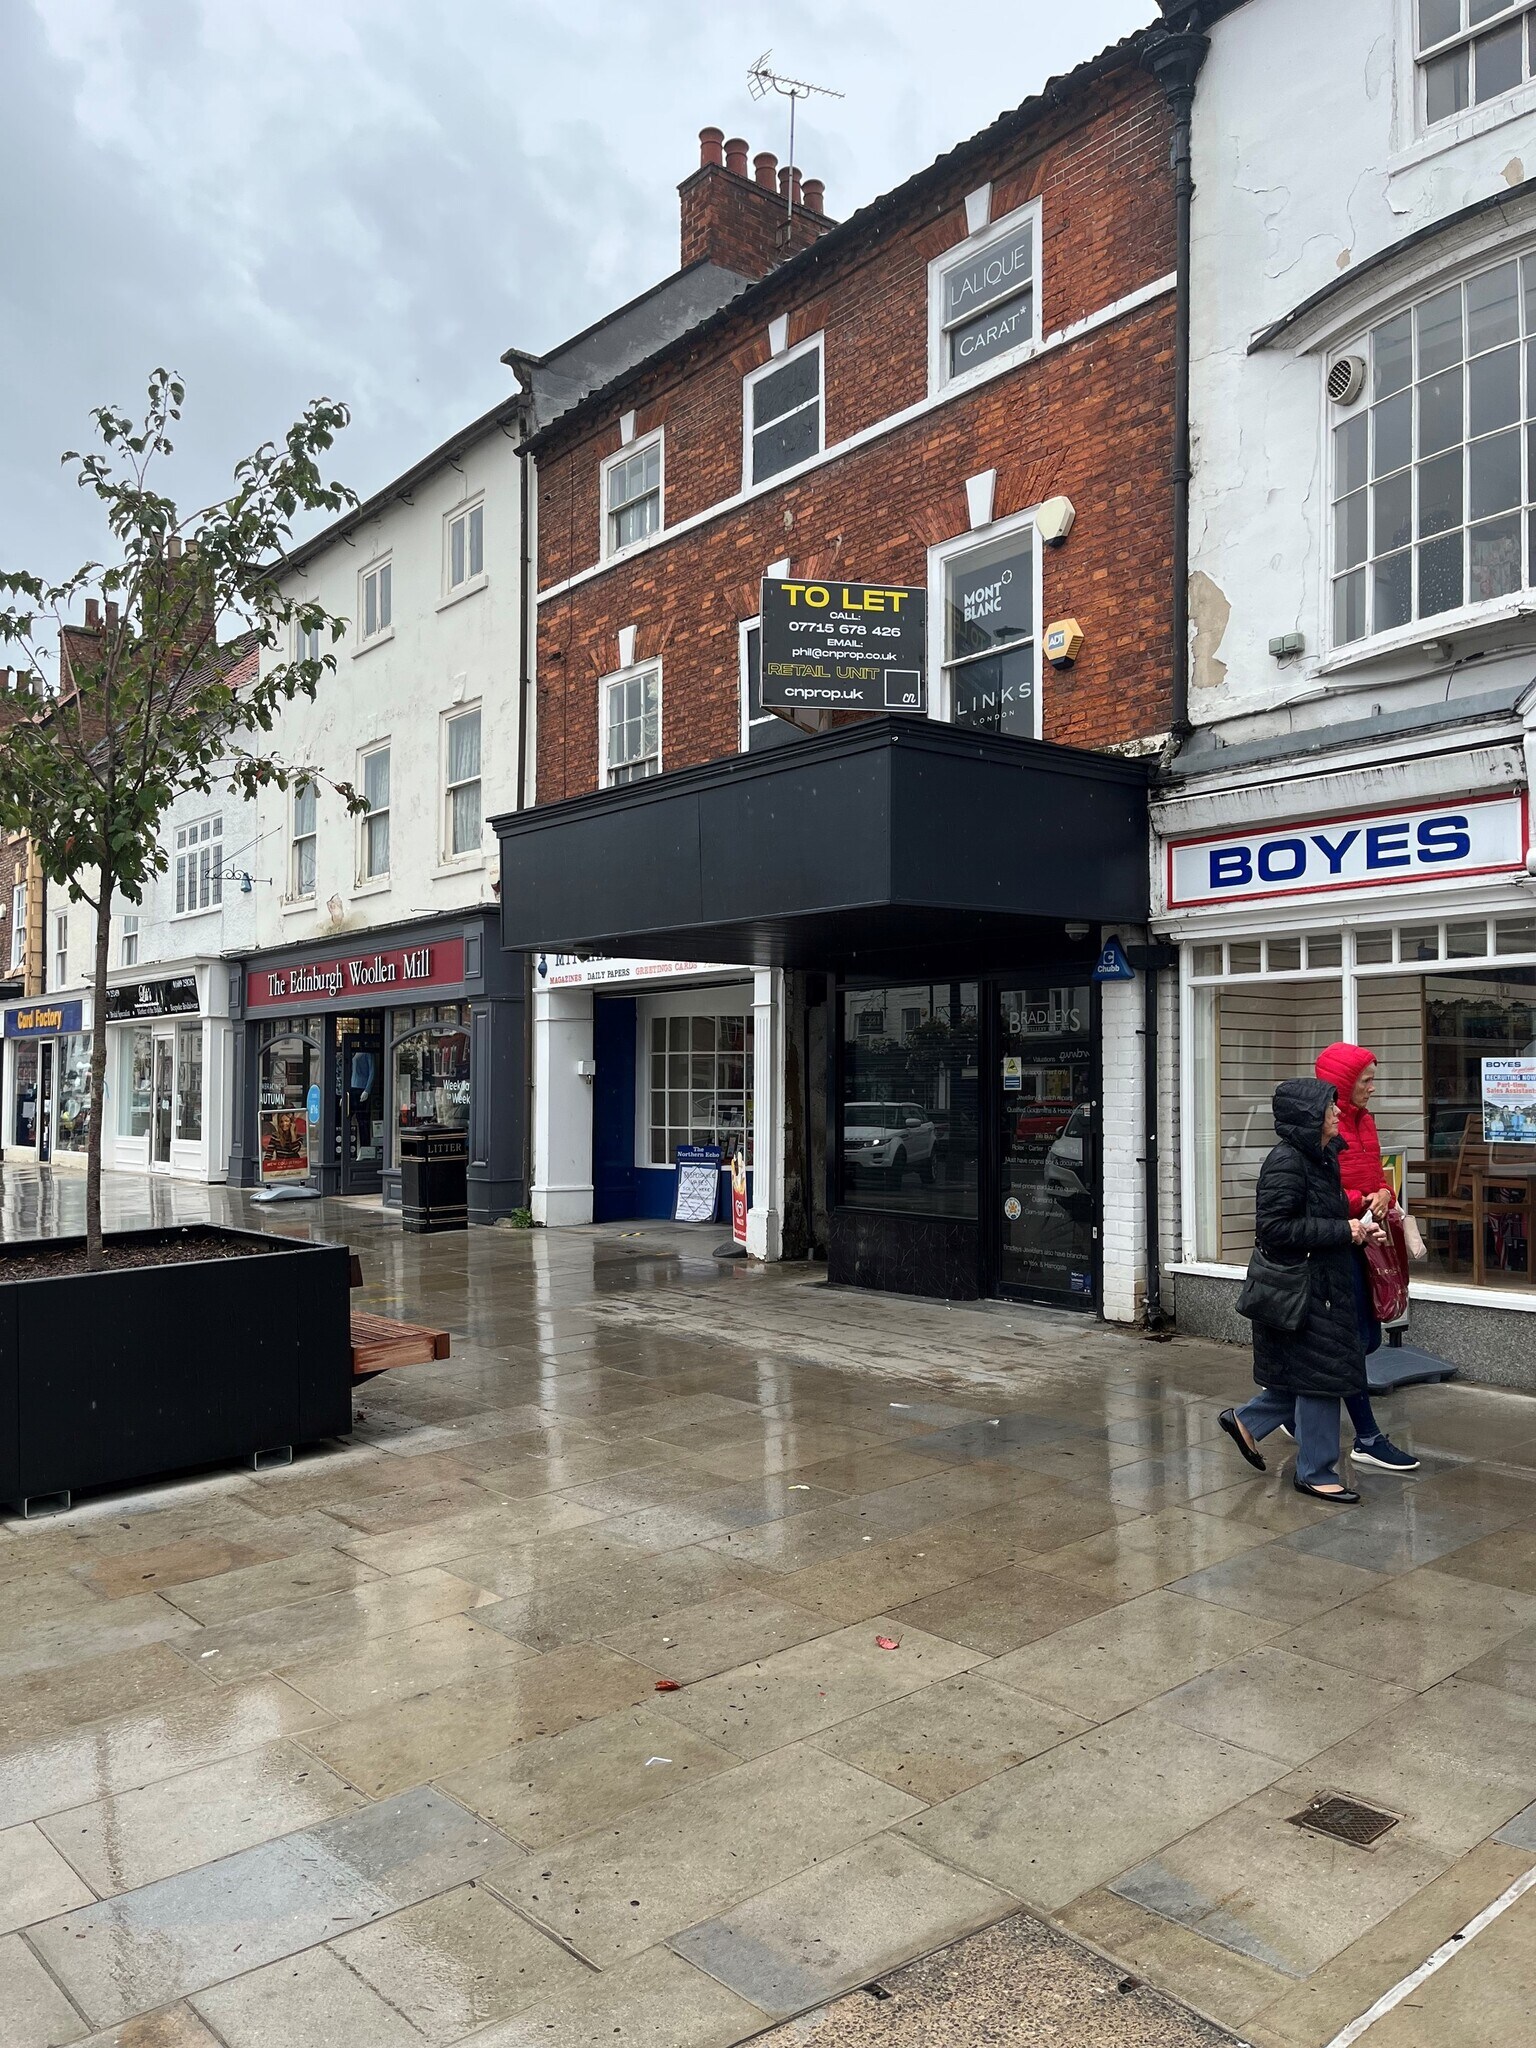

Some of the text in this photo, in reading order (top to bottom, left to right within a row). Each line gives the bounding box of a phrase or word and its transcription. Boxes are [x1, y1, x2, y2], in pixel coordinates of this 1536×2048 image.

[951, 244, 1025, 306] LALIQUE
[781, 584, 909, 613] TO LET
[964, 582, 1003, 608] MONT
[829, 611, 861, 621] CALL:
[964, 597, 1002, 622] BLANC
[788, 621, 901, 638] 07715 678 426
[827, 638, 864, 648] EMAIL:
[1049, 632, 1065, 647] ADT
[792, 647, 897, 661] phil@cnprop.co.uk
[767, 662, 881, 681] RETAIL UNIT
[784, 687, 864, 701] cnprop.uk
[957, 682, 1032, 716] LINKS
[972, 709, 1015, 726] LONDON
[1209, 815, 1471, 889] BOYES
[267, 948, 430, 997] The Edinburgh Woollen Mill
[549, 968, 630, 984] MAGAZINES DAILY PAPERS
[635, 963, 673, 975] GREETINGS
[674, 961, 698, 971] CARDS
[1097, 964, 1120, 973] Chubb
[17, 1008, 62, 1030] Card Factory
[1009, 1008, 1081, 1034] BRADLEYS
[260, 1093, 286, 1105] AUTUMN
[428, 1143, 462, 1154] LITTER
